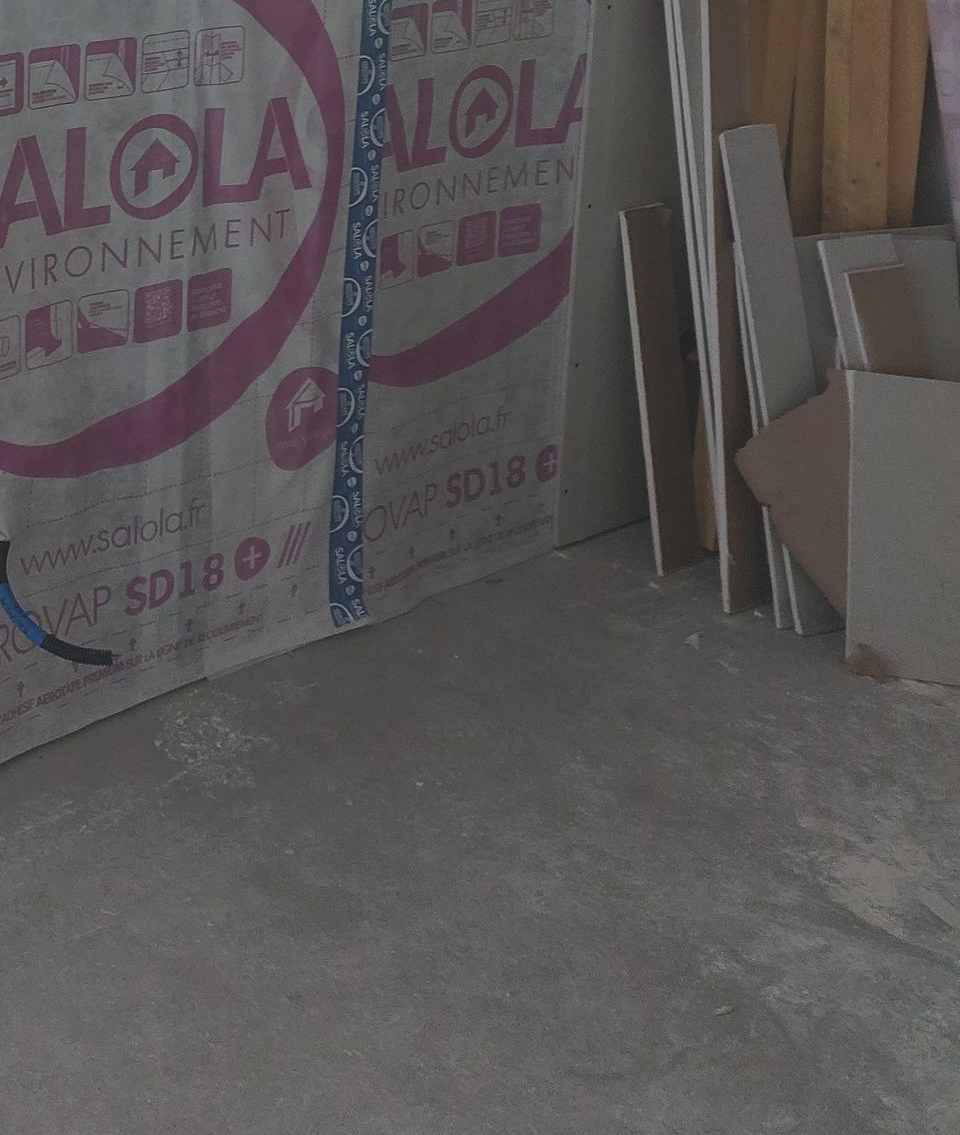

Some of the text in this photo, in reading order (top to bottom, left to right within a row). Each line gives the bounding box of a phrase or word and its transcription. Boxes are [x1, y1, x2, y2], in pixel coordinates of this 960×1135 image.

[374, 404, 513, 476] www.salola.fr
[445, 454, 527, 509] SD18
[19, 497, 205, 576] www.salola.fr
[124, 552, 225, 616] SD18
